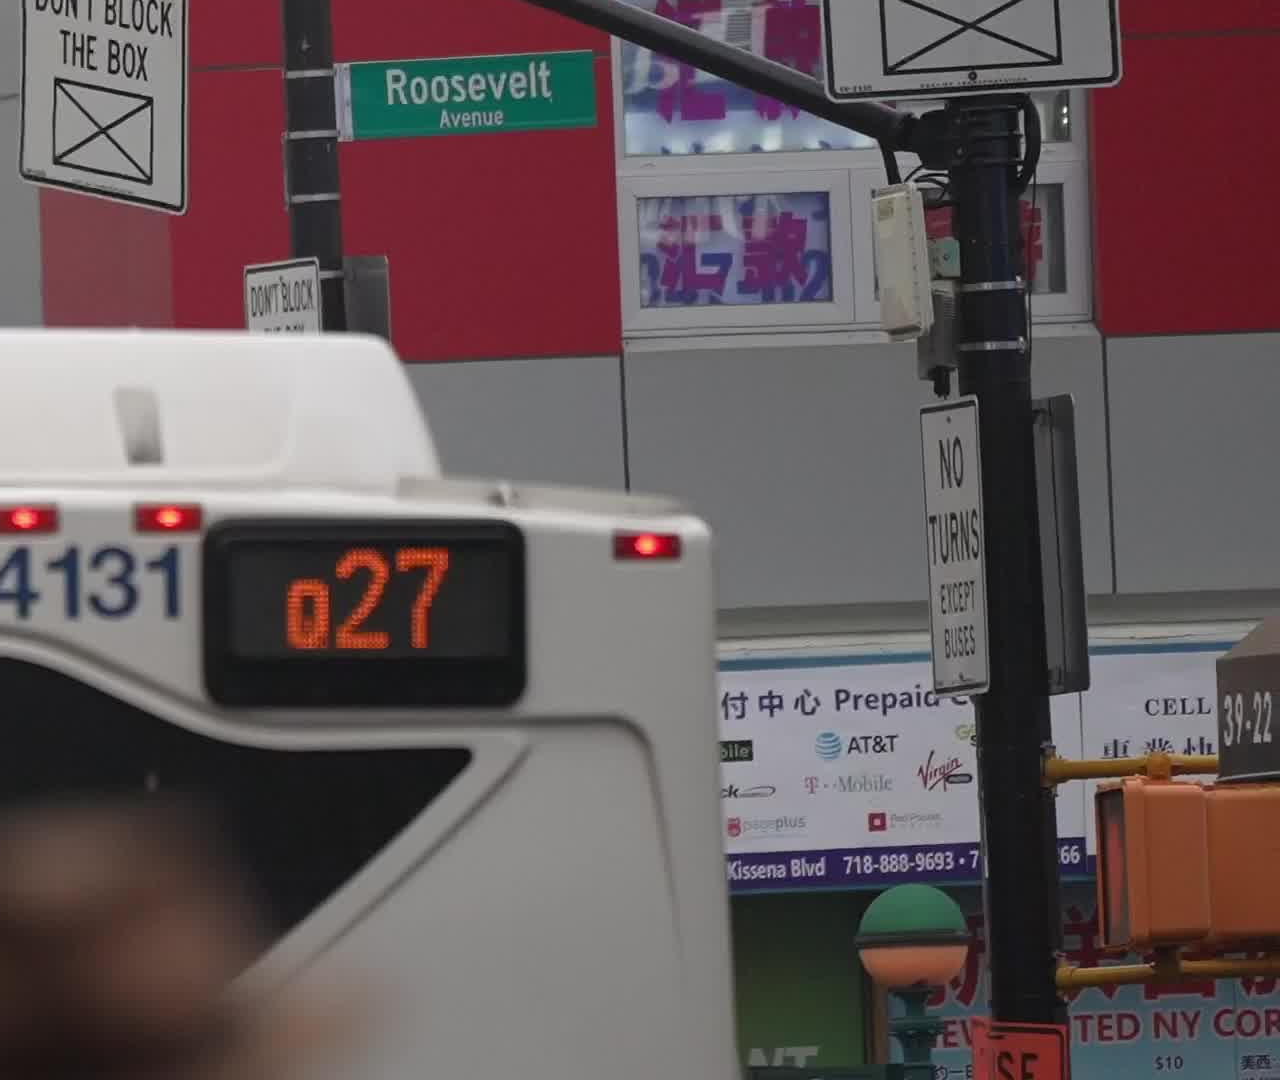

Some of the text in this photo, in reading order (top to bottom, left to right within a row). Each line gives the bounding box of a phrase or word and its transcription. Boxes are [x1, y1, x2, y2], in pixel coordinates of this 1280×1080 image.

[60, 29, 148, 81] THE BOX
[386, 60, 552, 106] Roosevelt
[440, 107, 504, 129] Avenue
[280, 279, 314, 313] BLOCK
[938, 435, 964, 489] NO
[928, 507, 980, 566] TURNS
[940, 580, 976, 615] EXCEPT
[944, 624, 976, 659] BUSES
[1144, 696, 1212, 717] CELL
[1223, 690, 1273, 747] 39-22
[847, 734, 900, 755] AT&T
[916, 750, 962, 793] Virgin
[727, 858, 787, 881] Kissena
[790, 856, 827, 878] Blvd
[842, 851, 955, 874] 718-888-9693
[1153, 1010, 1201, 1039] NY
[1154, 1055, 1184, 1071] $10
